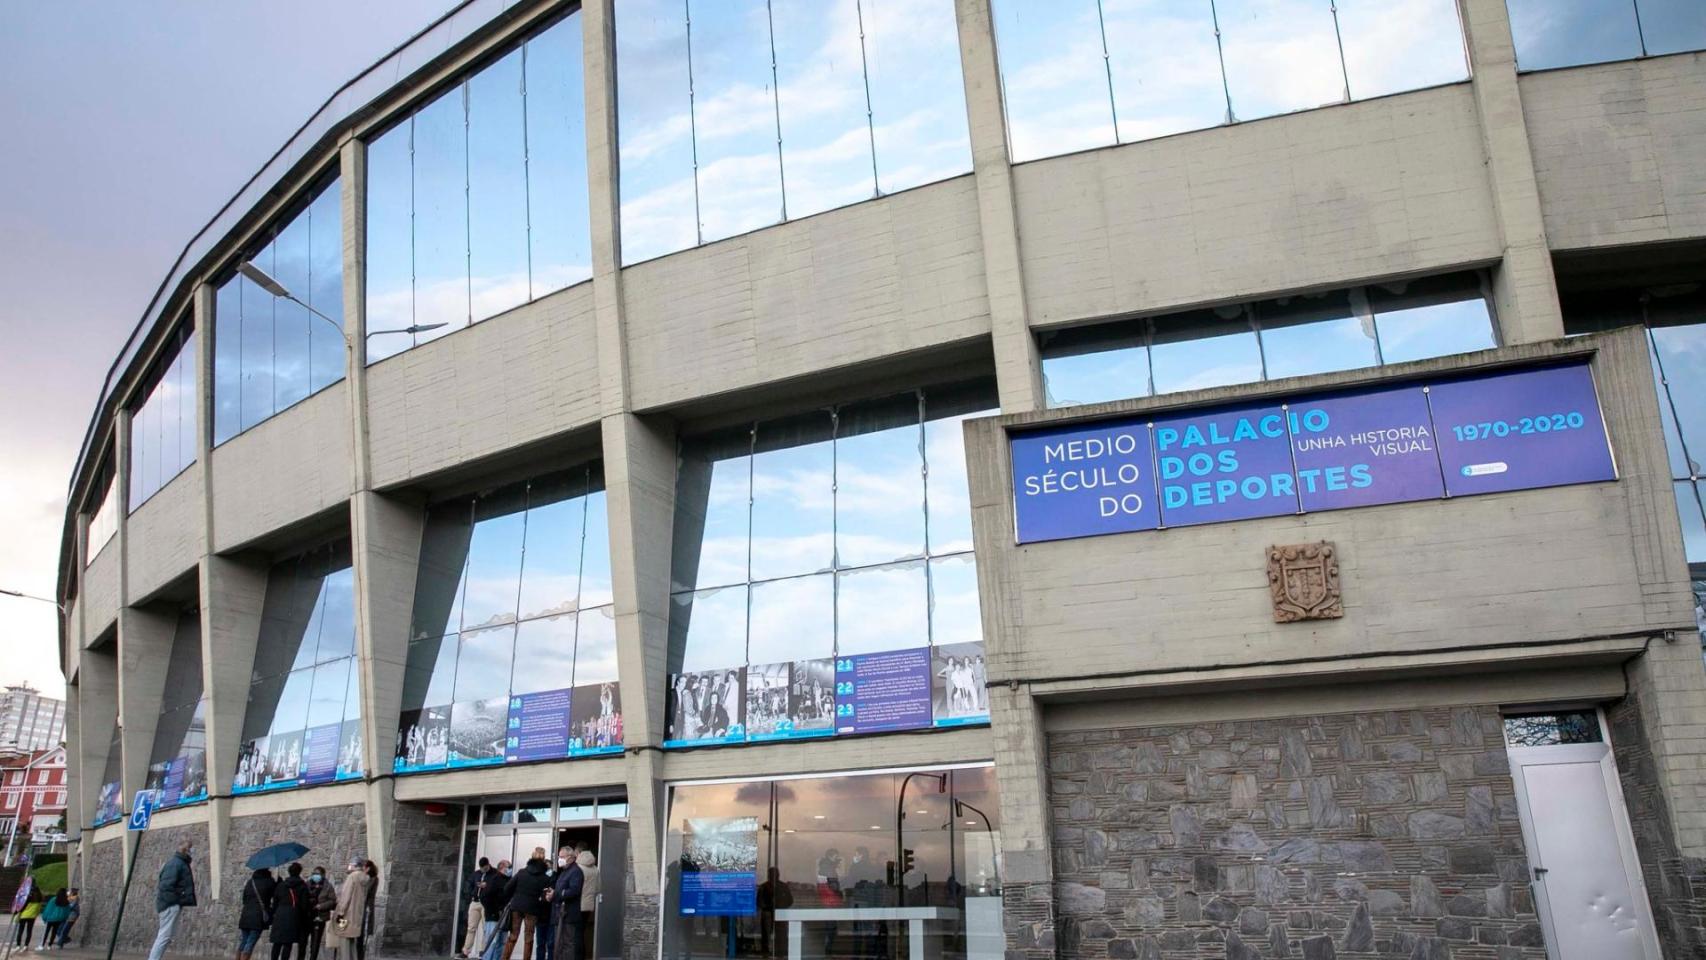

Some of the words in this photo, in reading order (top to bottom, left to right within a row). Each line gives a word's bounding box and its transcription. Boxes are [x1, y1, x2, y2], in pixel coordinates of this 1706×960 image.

[1157, 408, 1330, 451] PALACIO
[1297, 435, 1347, 452] UNHA
[1350, 425, 1430, 445] HISTORIA
[1452, 411, 1585, 442] 1970-2020
[1044, 434, 1136, 464] MEDIO
[1369, 439, 1432, 457] VISUAL
[1025, 463, 1140, 496] SÉCULO
[1161, 449, 1240, 480] DOS
[1164, 463, 1374, 509] DEPORTES
[1099, 494, 1142, 517] DO
[776, 719, 791, 730] 22
